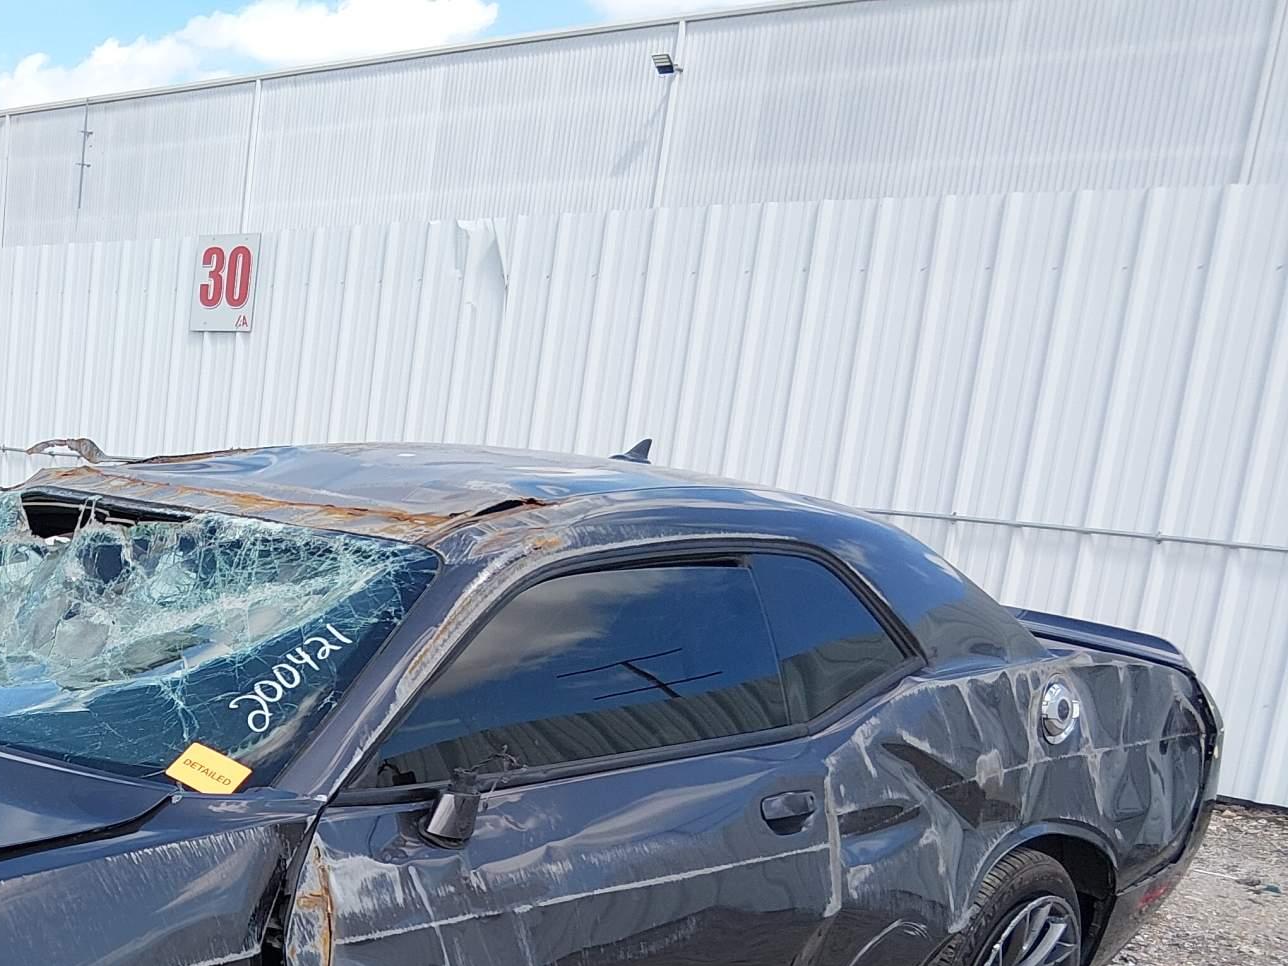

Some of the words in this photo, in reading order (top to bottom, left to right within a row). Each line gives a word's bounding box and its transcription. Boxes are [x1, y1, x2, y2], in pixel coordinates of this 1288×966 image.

[199, 245, 253, 309] 30
[229, 623, 353, 733] 200421
[182, 757, 232, 787] DETAILED
